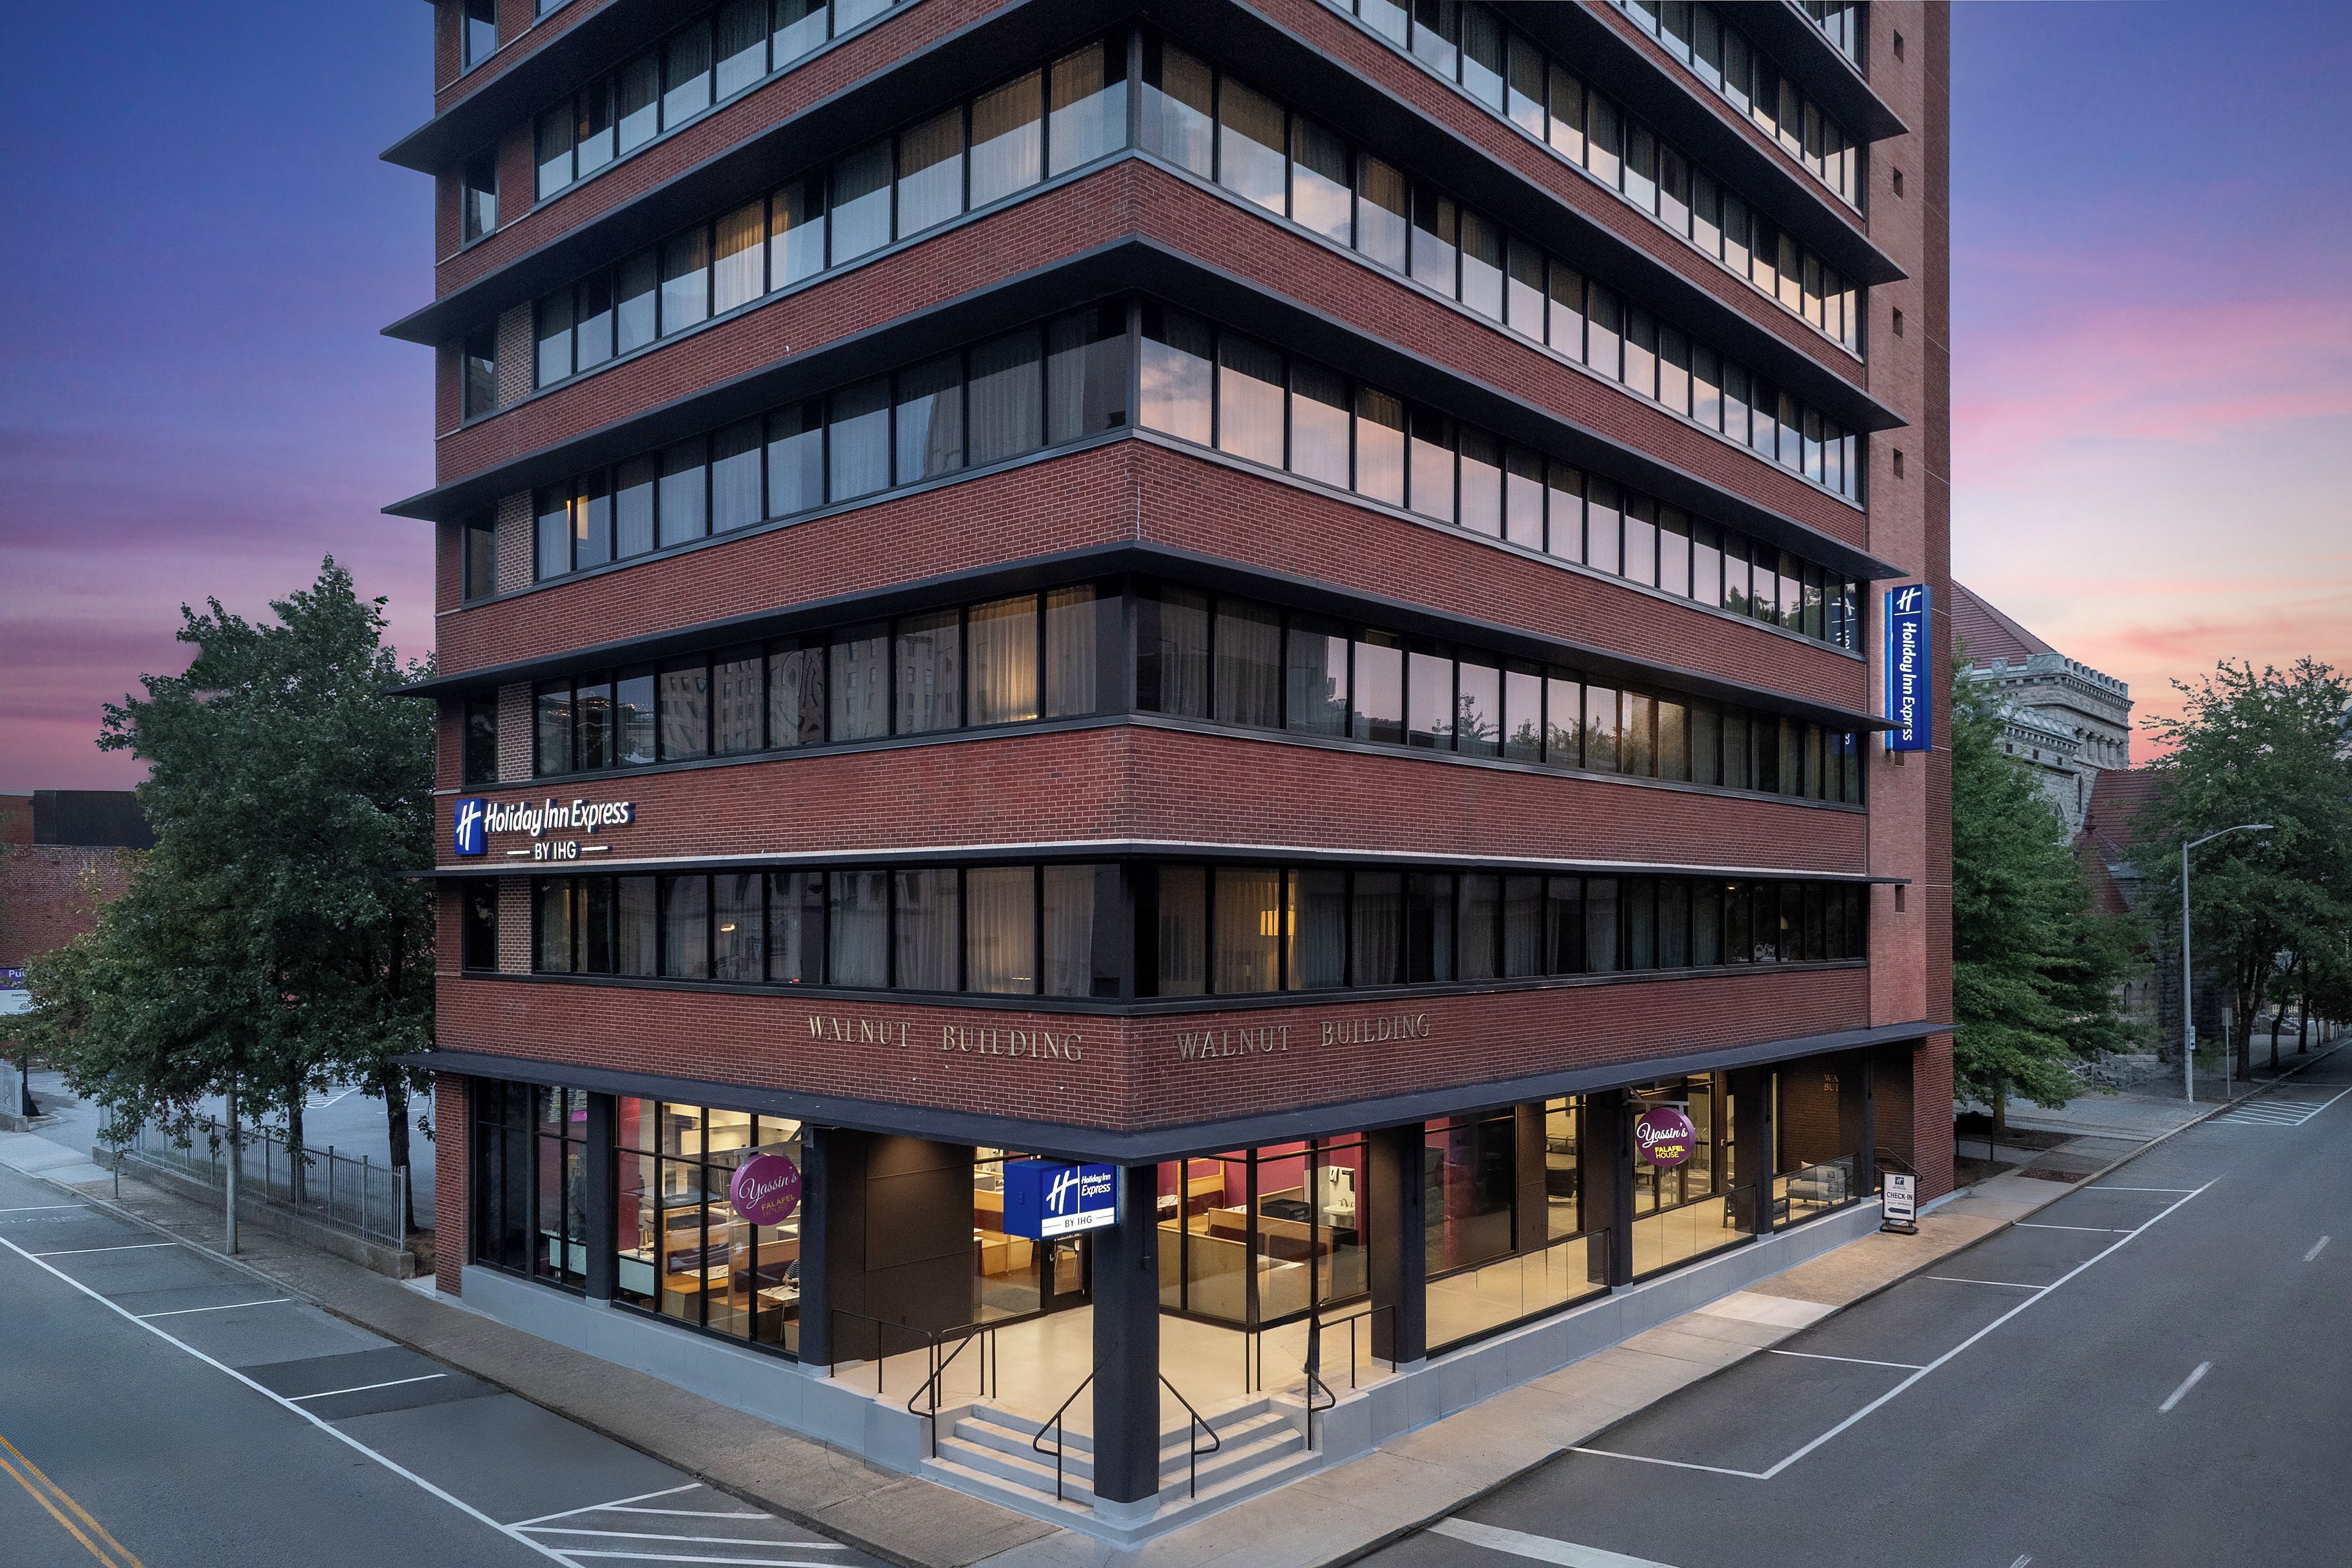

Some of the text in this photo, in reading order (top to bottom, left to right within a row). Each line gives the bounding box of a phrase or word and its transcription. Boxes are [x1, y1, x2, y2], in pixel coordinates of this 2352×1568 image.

[1899, 621, 1917, 741] Holiday Inn Exprss
[484, 802, 541, 837] Holiday
[544, 798, 569, 829] Inn
[571, 799, 629, 833] Express
[534, 840, 576, 860] BY IHG
[805, 1015, 1084, 1062] WALNUT BUILDING
[1174, 1014, 1430, 1061] WALNUT BUILDING
[1637, 1122, 1688, 1148] Yassin's
[739, 1166, 799, 1209] Yassin's
[1081, 1174, 1102, 1185] Holiday
[1081, 1183, 1111, 1197] Express
[761, 1194, 796, 1211] FALAFEL
[1887, 1191, 1913, 1200] CHECK-IN
[1065, 1215, 1092, 1228] BY IHG
